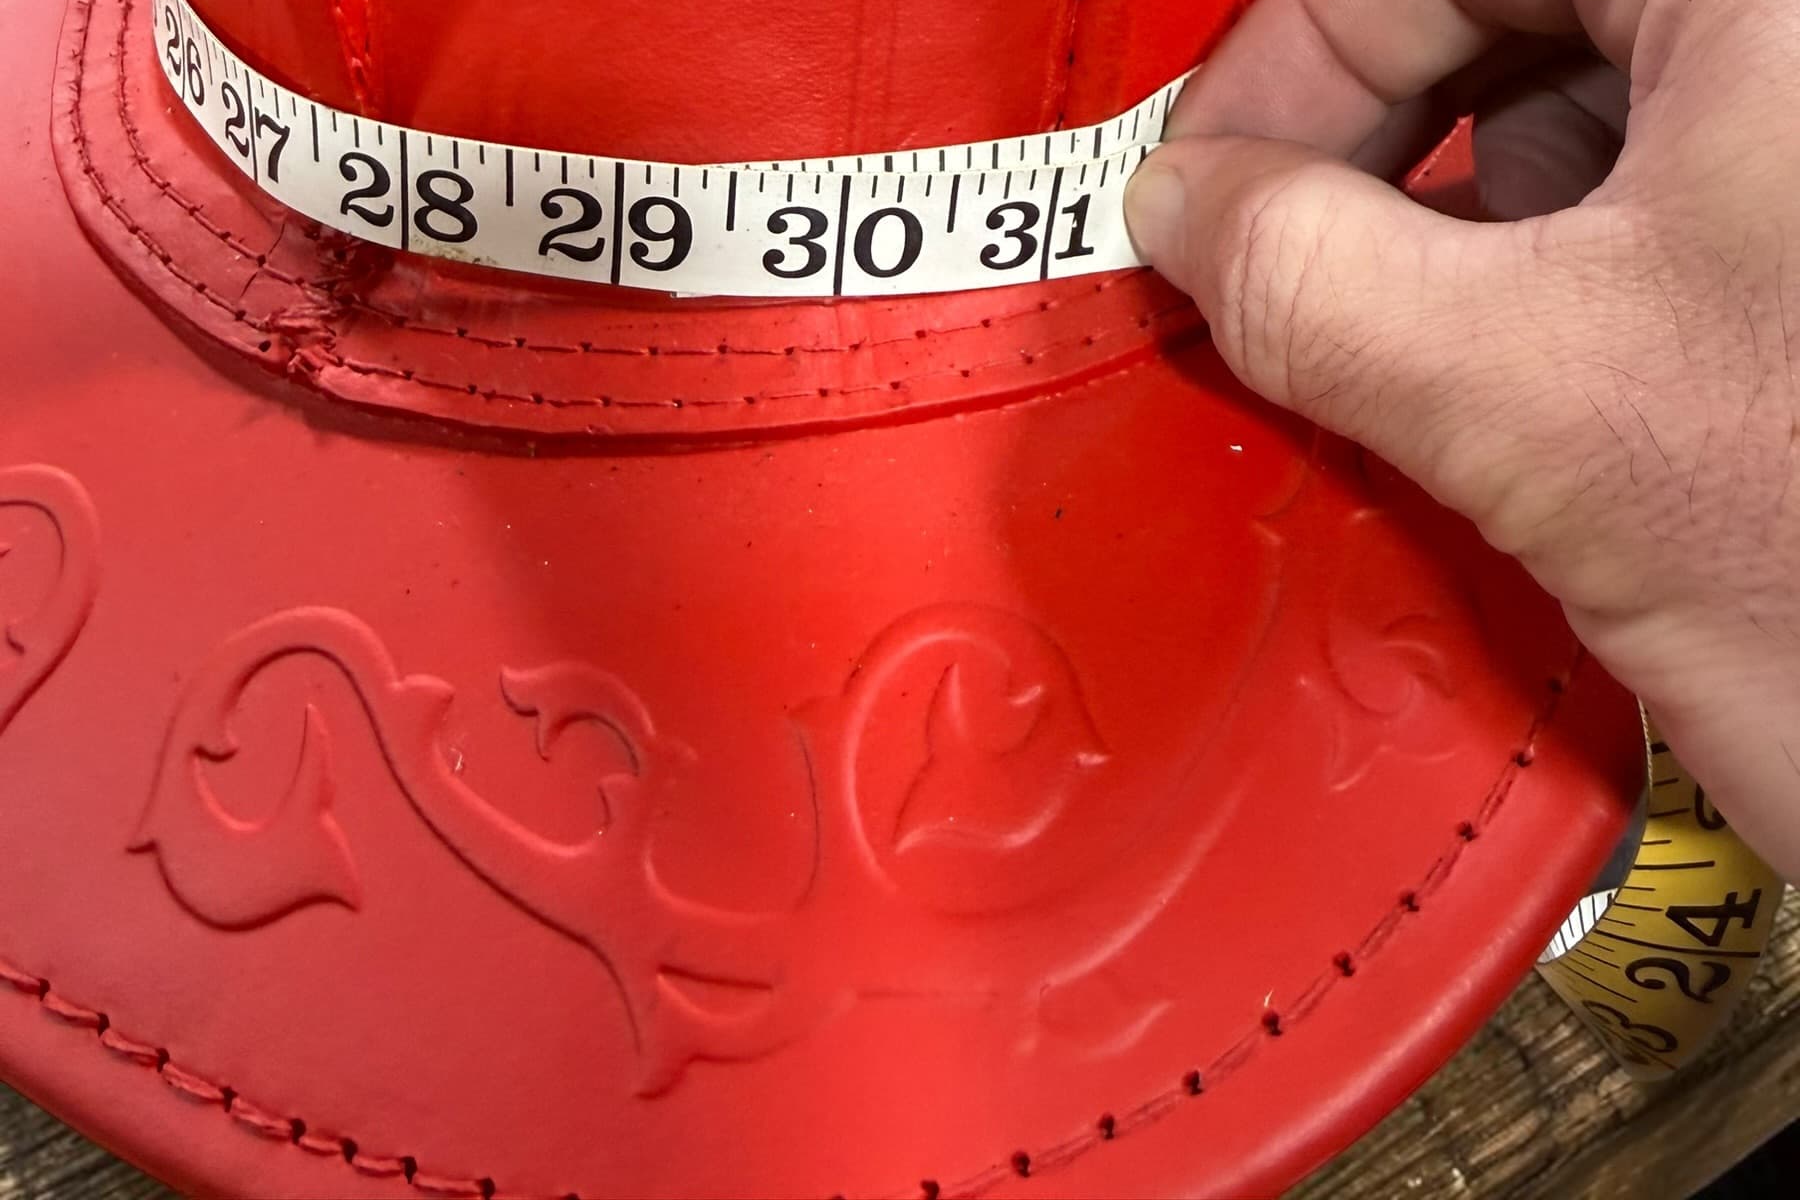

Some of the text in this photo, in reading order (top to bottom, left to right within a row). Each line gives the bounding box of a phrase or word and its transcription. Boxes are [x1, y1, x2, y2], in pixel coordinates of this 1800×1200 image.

[165, 4, 1095, 279] 26 27 28 29 30 31
[1624, 887, 1763, 1003] 24
